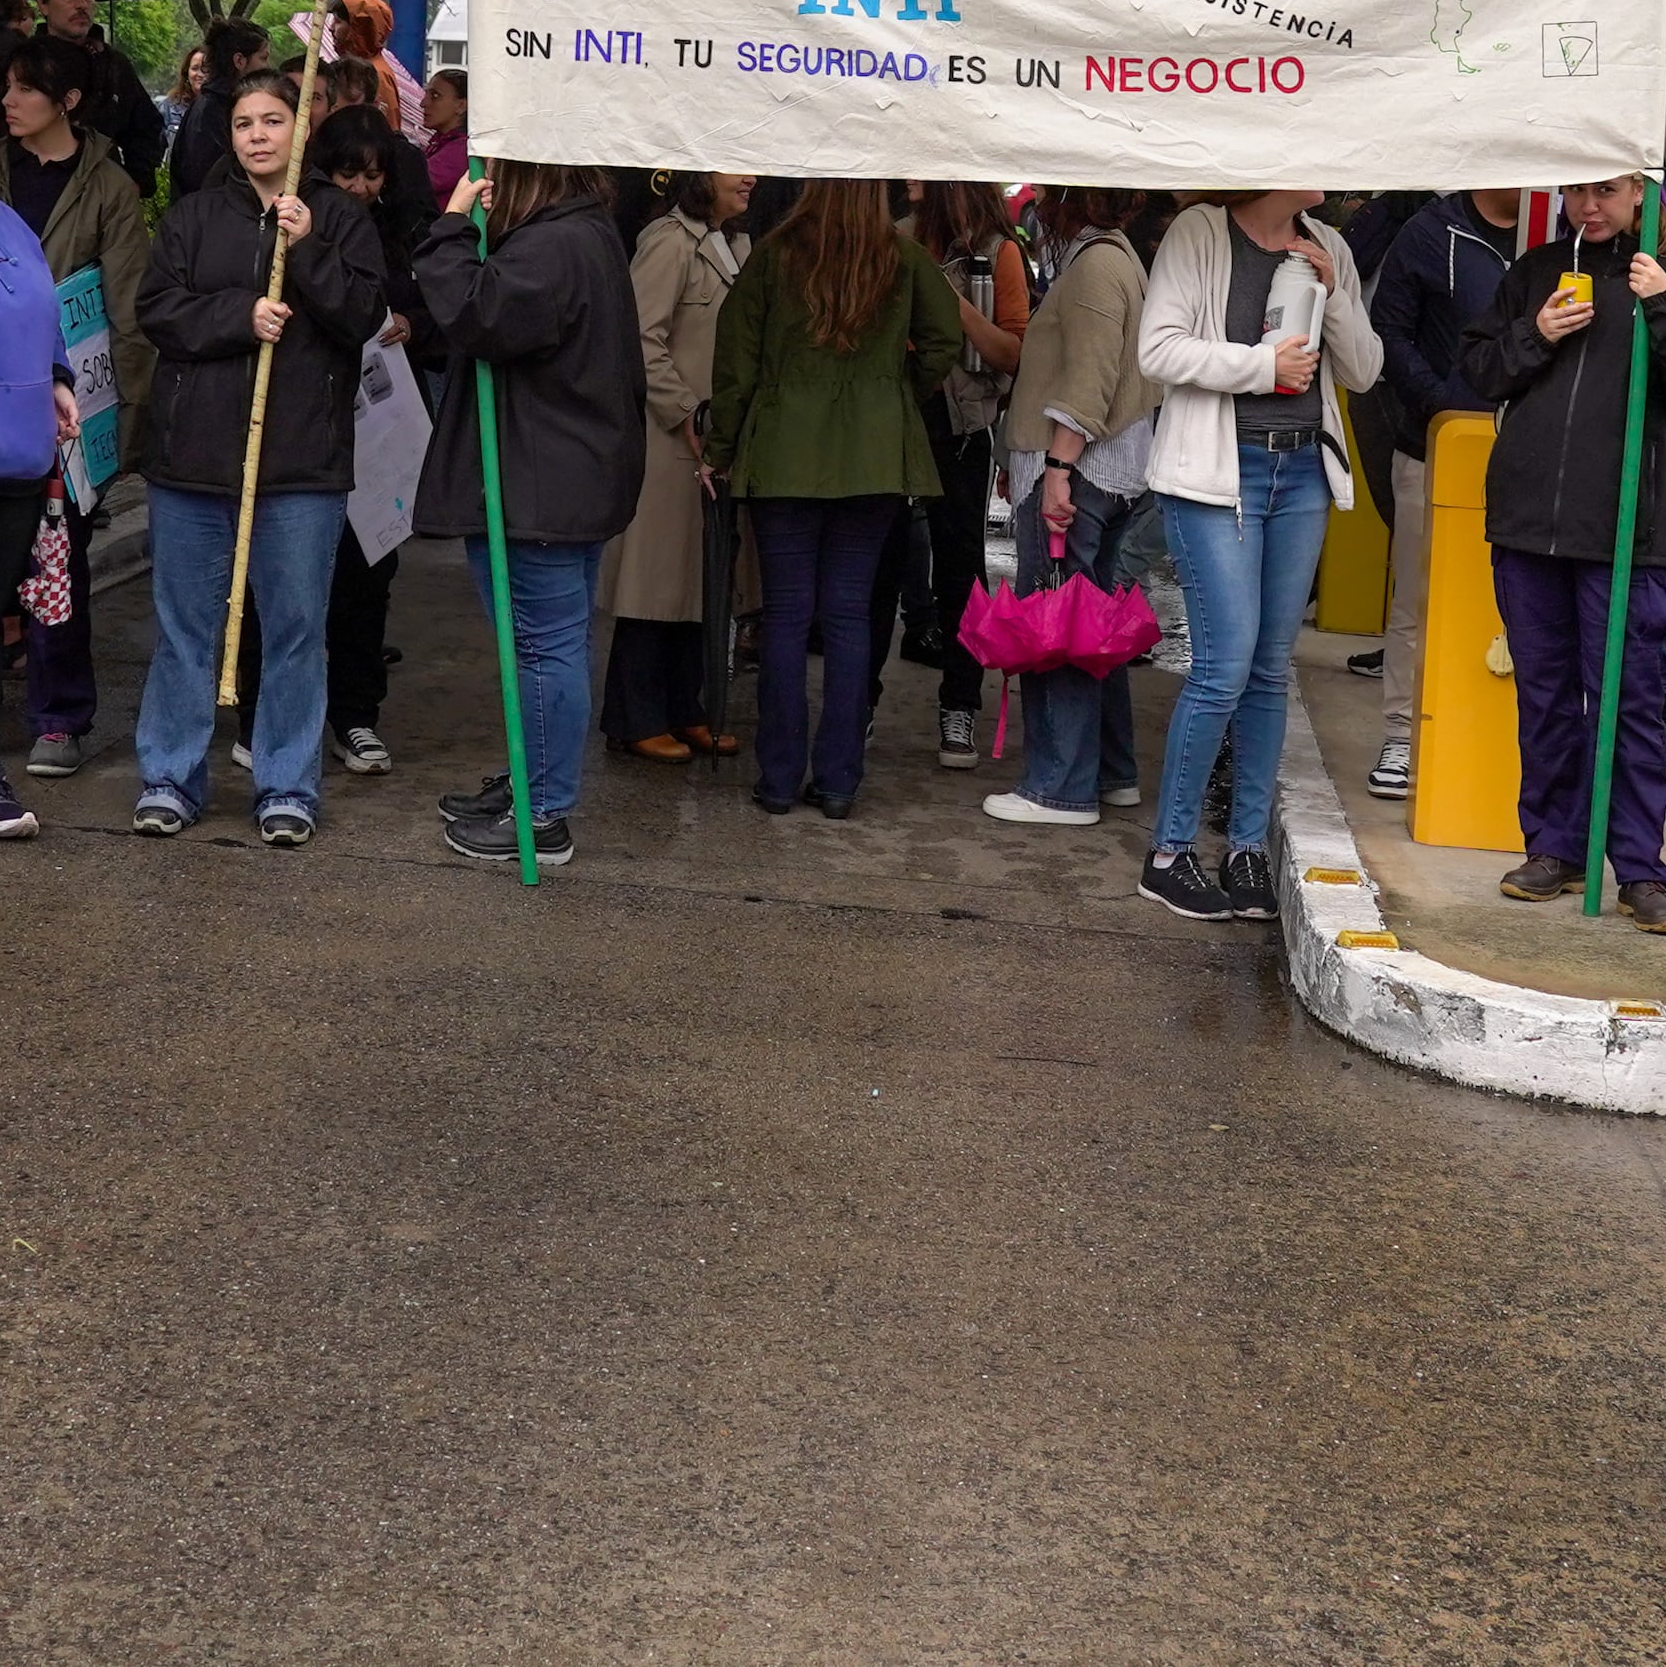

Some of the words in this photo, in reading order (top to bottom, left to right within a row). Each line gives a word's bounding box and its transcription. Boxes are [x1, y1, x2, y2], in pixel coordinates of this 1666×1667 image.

[505, 28, 552, 60] SIN
[574, 29, 649, 70] INTI,
[673, 38, 713, 69] TU
[737, 41, 928, 82] SEGURIDAD
[948, 55, 987, 85] ES
[1015, 58, 1061, 89] UN
[1085, 55, 1306, 94] NEGOCIO
